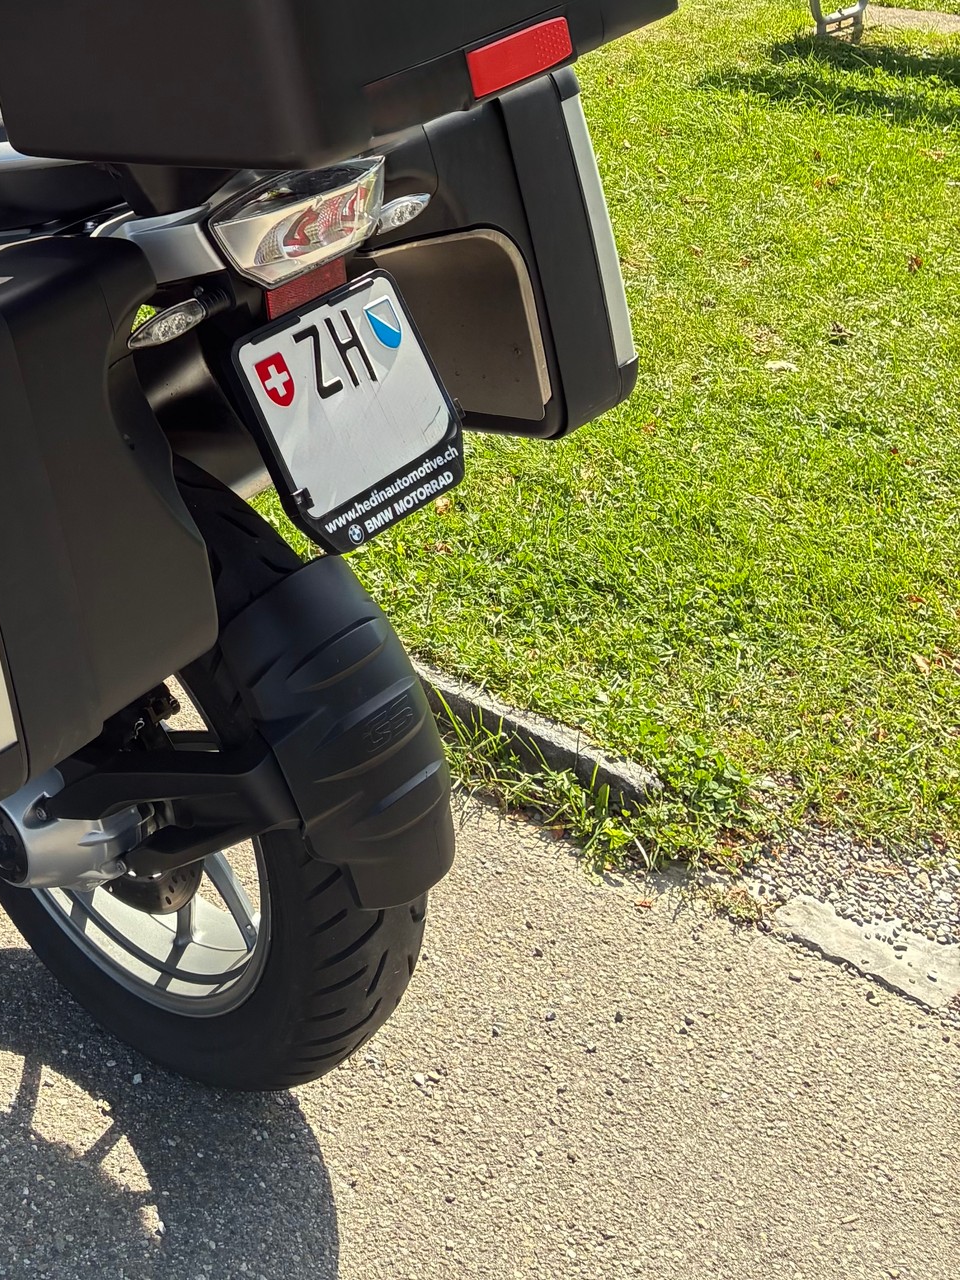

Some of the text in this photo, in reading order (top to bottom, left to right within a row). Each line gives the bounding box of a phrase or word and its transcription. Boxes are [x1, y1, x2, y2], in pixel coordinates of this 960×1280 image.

[292, 309, 378, 400] ZH
[324, 445, 459, 535] www.hedinautomotive.ch
[364, 506, 394, 534] BMW
[393, 471, 454, 516] MOTORRAD
